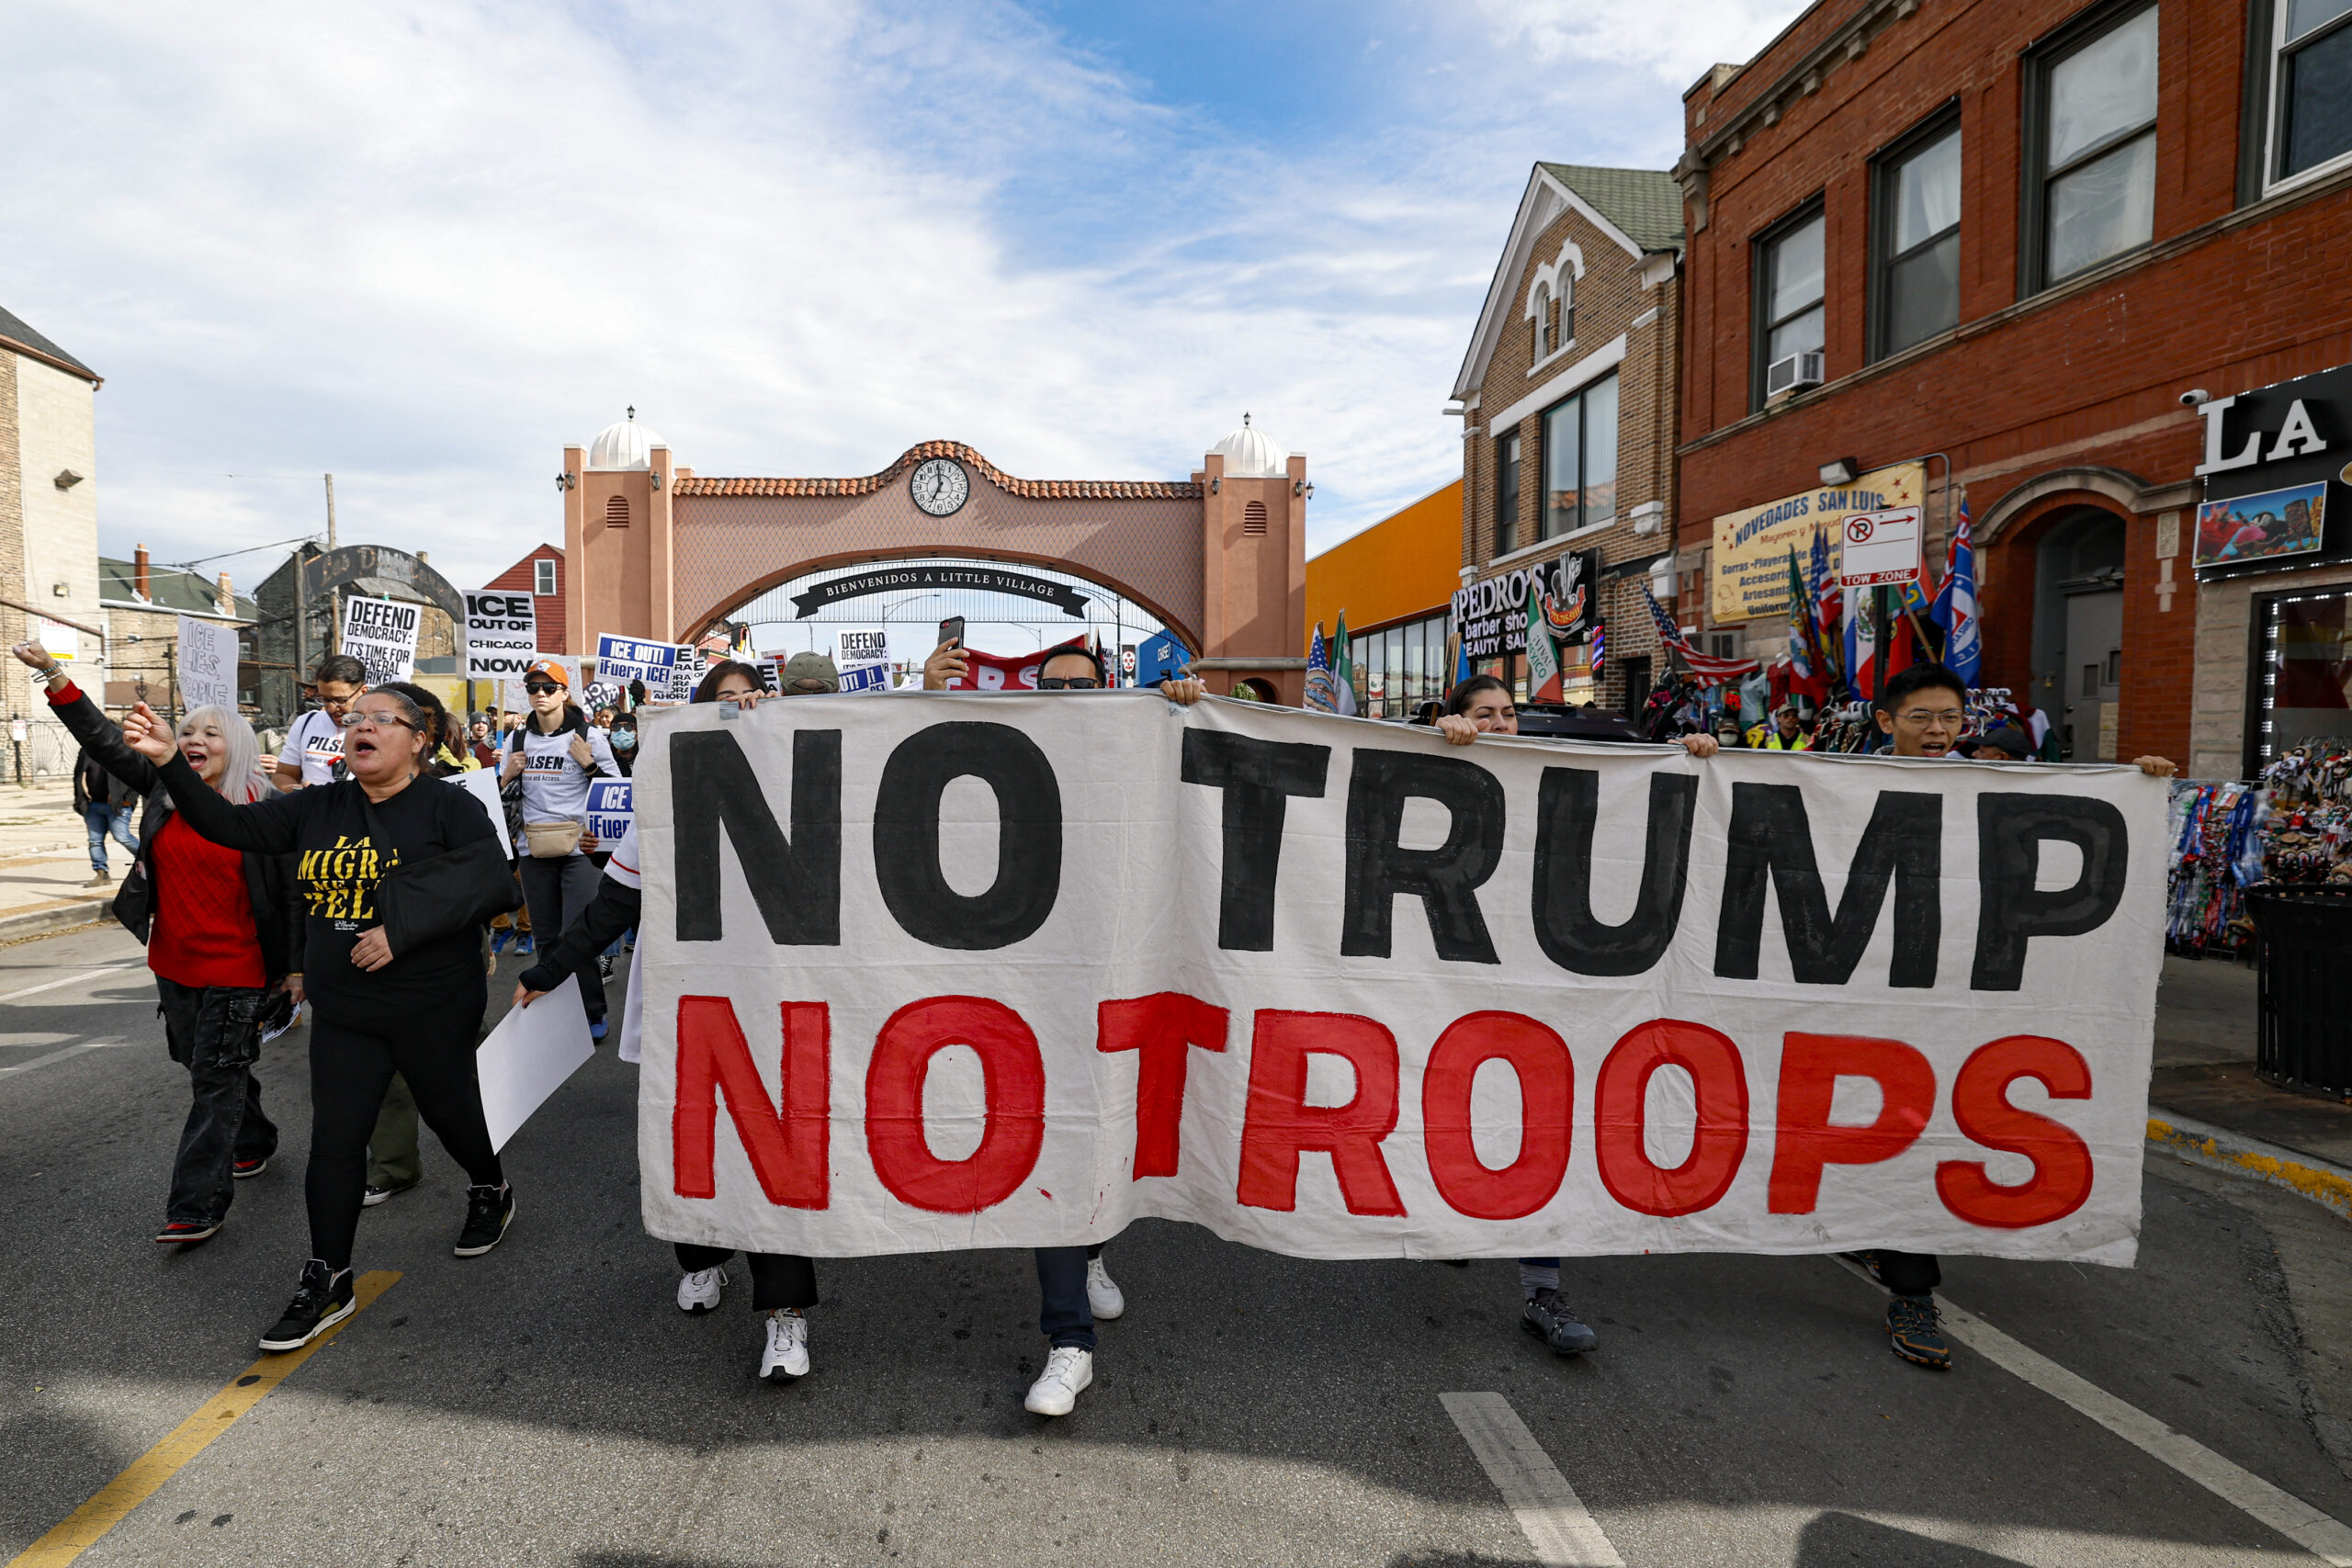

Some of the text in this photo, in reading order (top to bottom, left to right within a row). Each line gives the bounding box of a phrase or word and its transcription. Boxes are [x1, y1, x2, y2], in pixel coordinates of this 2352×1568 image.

[2195, 395, 2326, 476] LA
[1736, 491, 1884, 547] NOVEDADES SAN LUIS
[1722, 561, 1749, 575] Gorras
[1739, 569, 1791, 587] Accesorio
[1845, 570, 1912, 585] TOW ZONE
[825, 572, 1055, 597] BIENVENIDOS A LITTLE VILLAGE
[1457, 563, 1545, 624] PEDRO'S
[1743, 583, 1791, 602] Artesania
[351, 600, 415, 630] DEFEND
[466, 595, 533, 618] ICE
[348, 623, 413, 645] DEMOCRACY:
[469, 618, 533, 631] OUT OF
[1465, 610, 1528, 640] barber sho
[187, 621, 215, 652] ICE
[469, 640, 533, 649] CHICAGO
[842, 632, 886, 649] DEFEND
[1464, 633, 1527, 657] EAUTY SAL
[183, 645, 220, 680] LIES,
[345, 641, 410, 663] IT'S TIME FOR
[610, 640, 633, 660] ICE
[634, 644, 665, 664] OUT!
[842, 649, 888, 660] DEMOCRACY:
[470, 658, 534, 673] NOW
[646, 666, 671, 683] ICE!
[366, 671, 392, 684] RIKE!
[839, 673, 859, 692] UT!
[307, 736, 345, 752] PILS
[526, 756, 564, 770] ILSEN
[542, 774, 560, 783] Access
[601, 786, 630, 809] ICE
[589, 815, 632, 840] ¡Fuer
[334, 835, 371, 849] LA
[672, 721, 2128, 991] NO TRUMP
[671, 991, 2094, 1230] NO TROOPS
